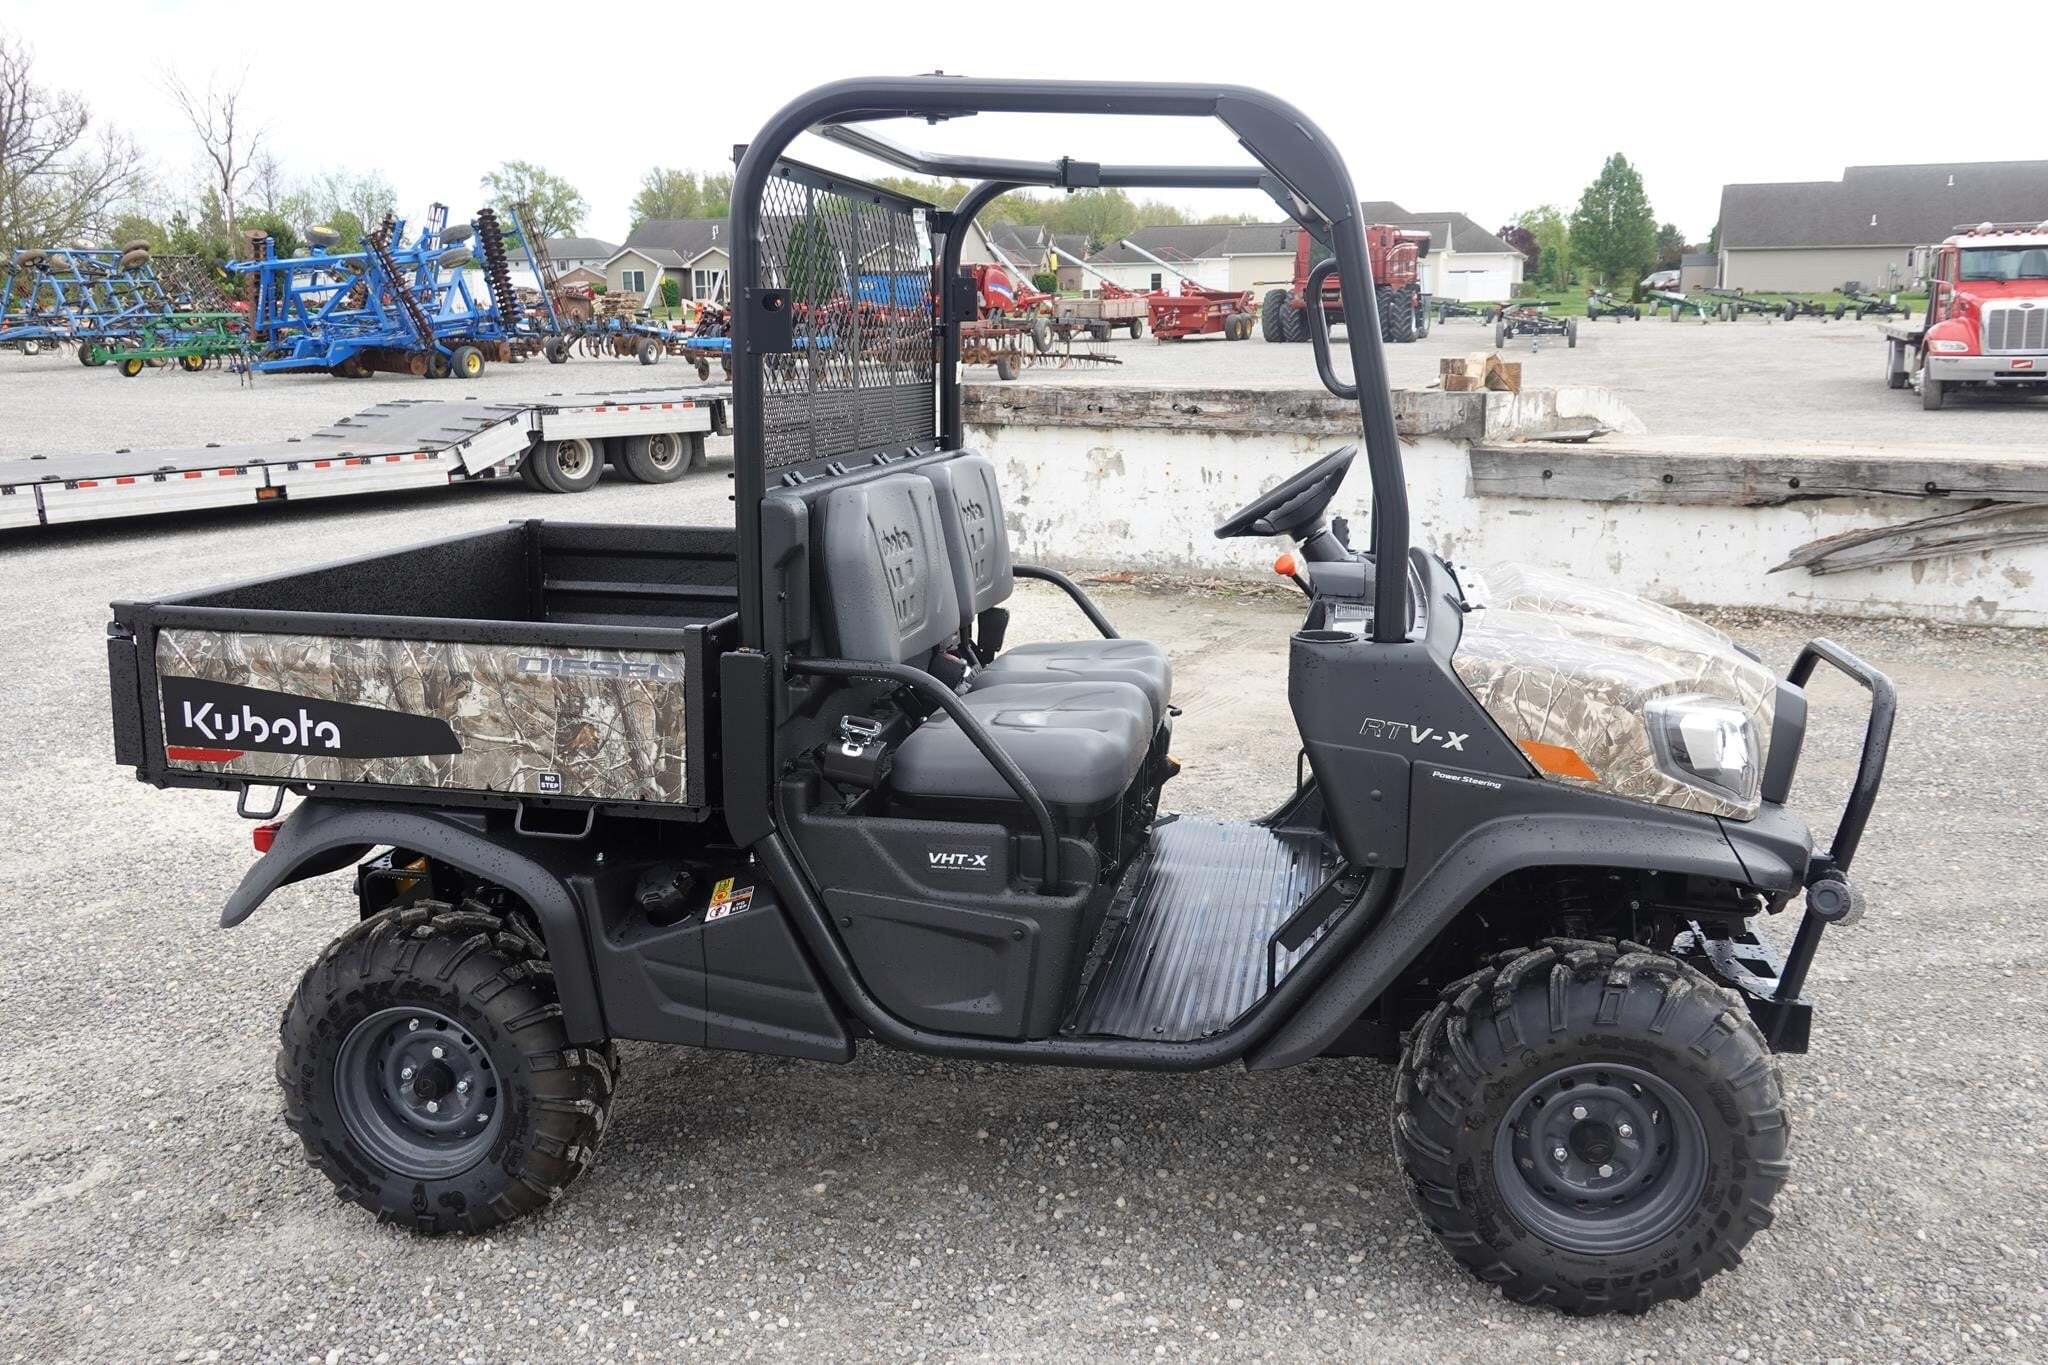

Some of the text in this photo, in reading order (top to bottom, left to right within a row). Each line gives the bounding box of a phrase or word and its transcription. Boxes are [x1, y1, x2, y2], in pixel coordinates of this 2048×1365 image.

[516, 656, 676, 679] DIESEL
[183, 701, 341, 749] Kubota
[1359, 717, 1470, 751] RTV-X
[1432, 770, 1502, 789] Power Steering
[929, 852, 989, 866] VHT-X
